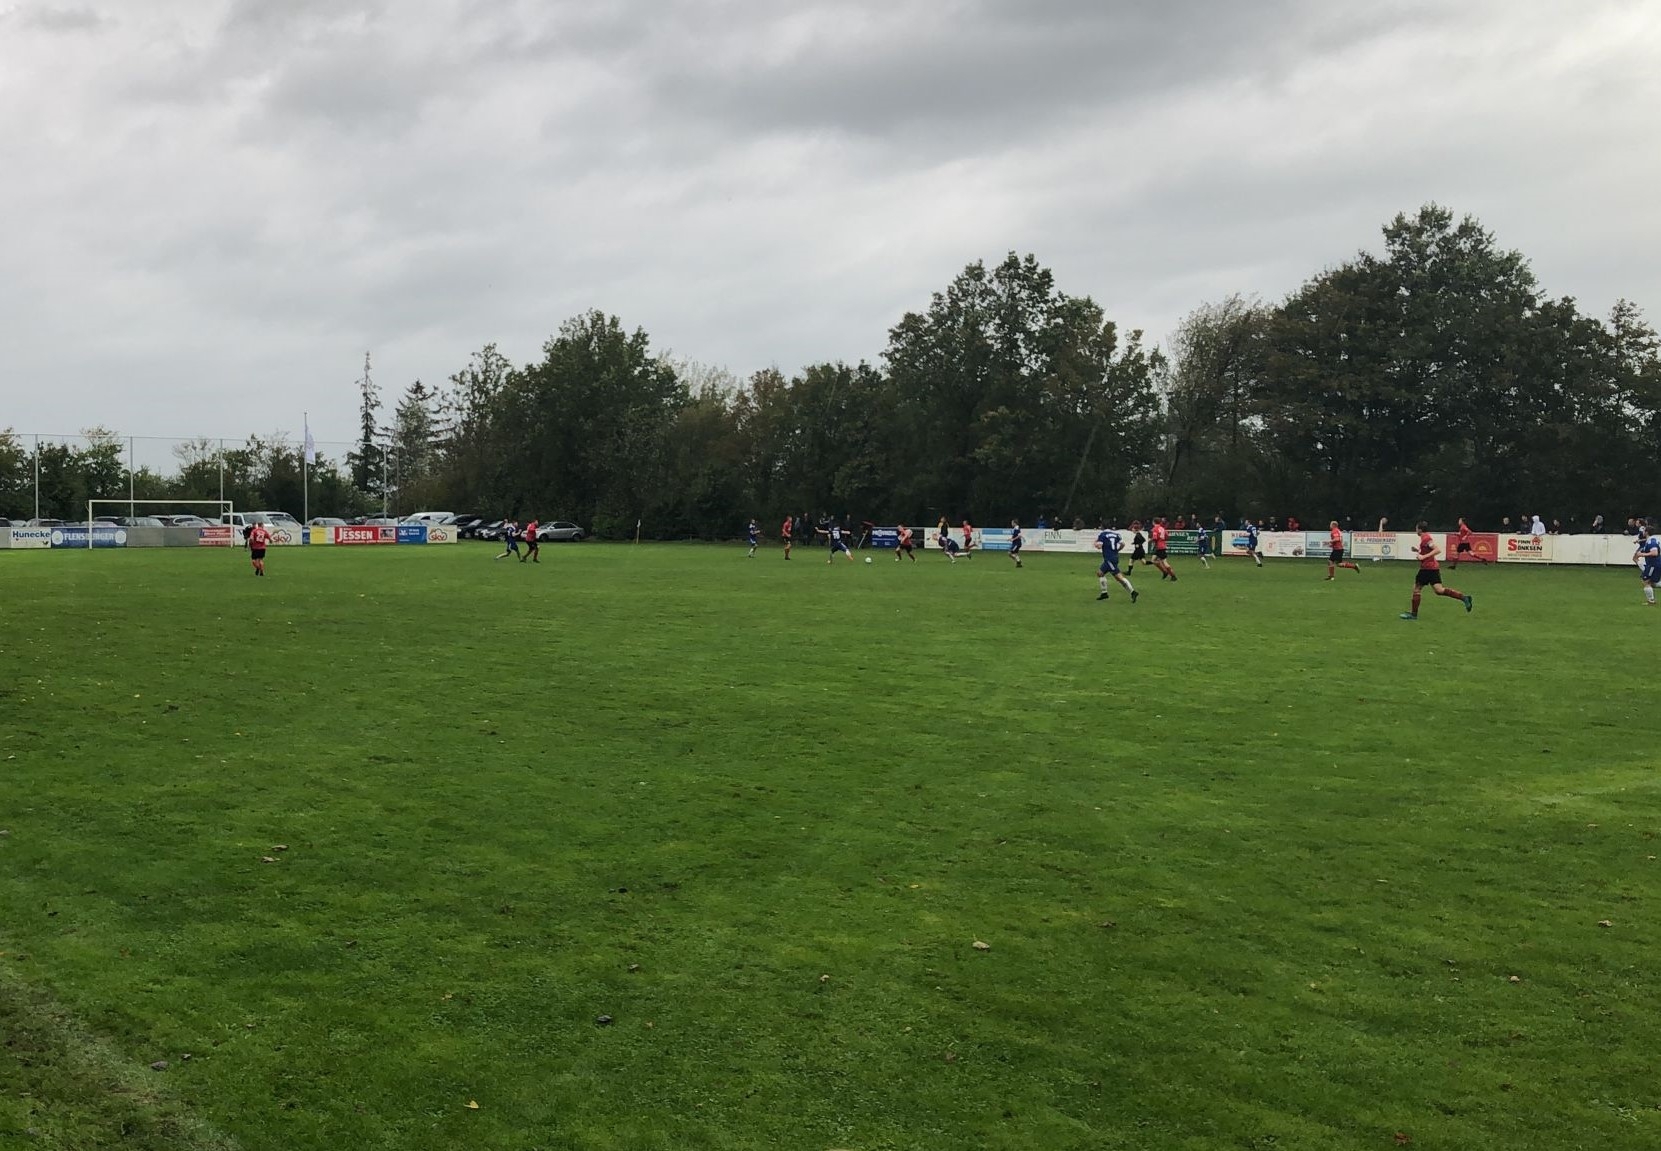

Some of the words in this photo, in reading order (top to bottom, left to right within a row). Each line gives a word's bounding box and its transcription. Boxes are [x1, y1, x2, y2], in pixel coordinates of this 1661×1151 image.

[12, 530, 50, 538] Hunecke
[336, 527, 373, 542] JESSEN
[1045, 531, 1062, 539] FINN
